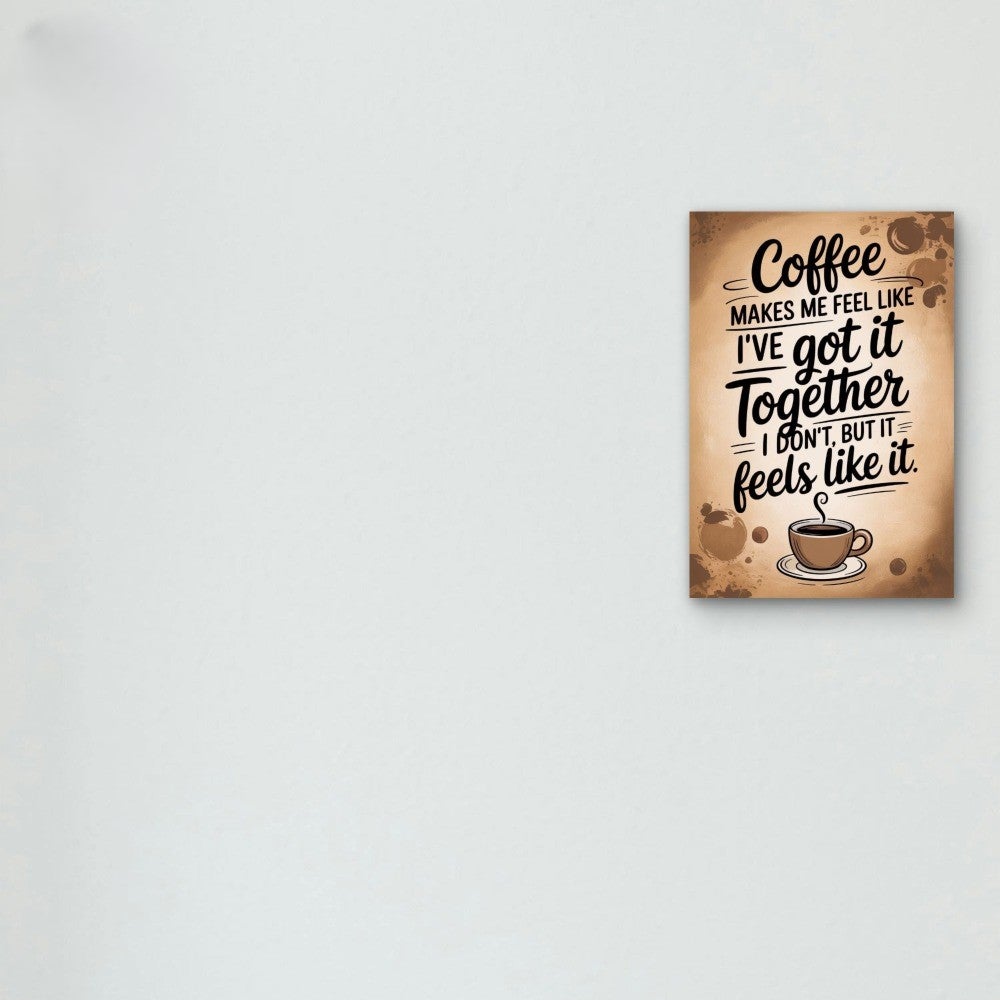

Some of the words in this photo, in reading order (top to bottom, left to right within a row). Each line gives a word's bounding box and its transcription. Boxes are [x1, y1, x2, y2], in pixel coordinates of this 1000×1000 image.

[752, 233, 886, 295] Coffee
[731, 300, 795, 326] MAKES
[801, 297, 828, 319] ME
[833, 292, 873, 315] FEEL
[878, 286, 915, 310] LIKE
[737, 332, 784, 364] I'VE
[792, 318, 862, 385] got
[870, 312, 904, 359] it
[725, 364, 910, 438] Together
[762, 433, 768, 456] I
[776, 425, 836, 454] DON'T,
[841, 420, 876, 444] BUT
[880, 417, 896, 438] IT
[733, 454, 817, 513] feels
[823, 445, 883, 487] like
[888, 438, 918, 475] it.
